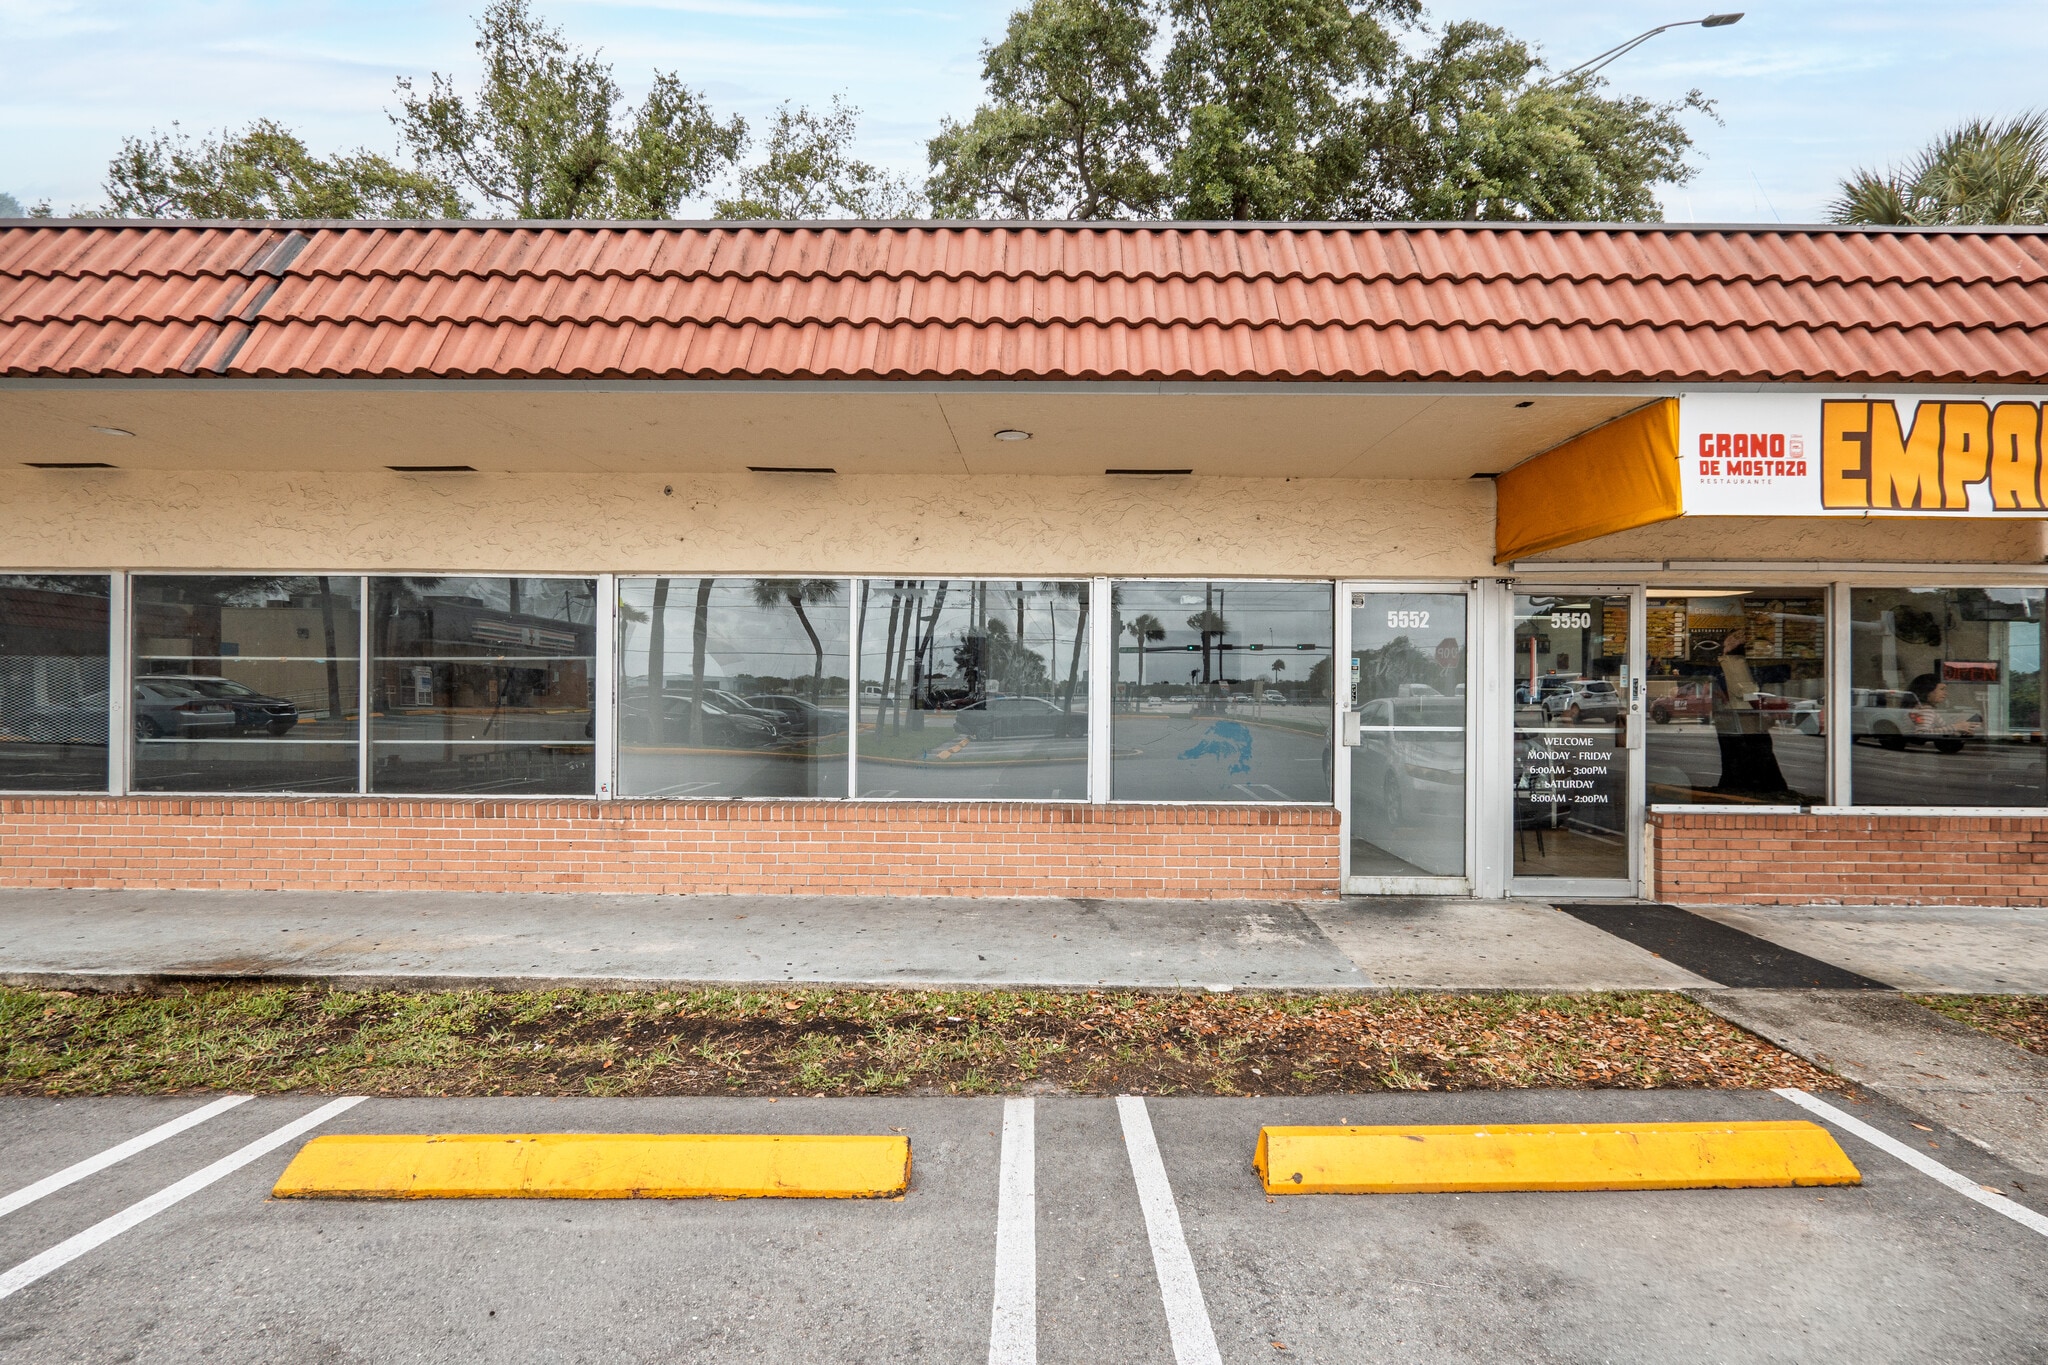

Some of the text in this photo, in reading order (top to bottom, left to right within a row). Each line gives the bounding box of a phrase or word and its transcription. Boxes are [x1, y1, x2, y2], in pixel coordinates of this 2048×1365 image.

[1699, 433, 1785, 458] GRANO
[1820, 399, 2048, 512] EMPA
[1699, 460, 1807, 476] DE MOSTAZA
[1387, 611, 1430, 629] 5552
[1551, 612, 1591, 629] 5550
[1543, 737, 1594, 746] WELCOME
[1527, 751, 1570, 760] MONDAY
[1579, 752, 1612, 760] FRIDAY
[1529, 766, 1565, 774] 6:00AM
[1573, 766, 1607, 776] 3:00PM
[1544, 780, 1594, 789] SATURDAY
[1530, 793, 1566, 803] 8:00AM
[1574, 794, 1608, 803] 2:00PM
